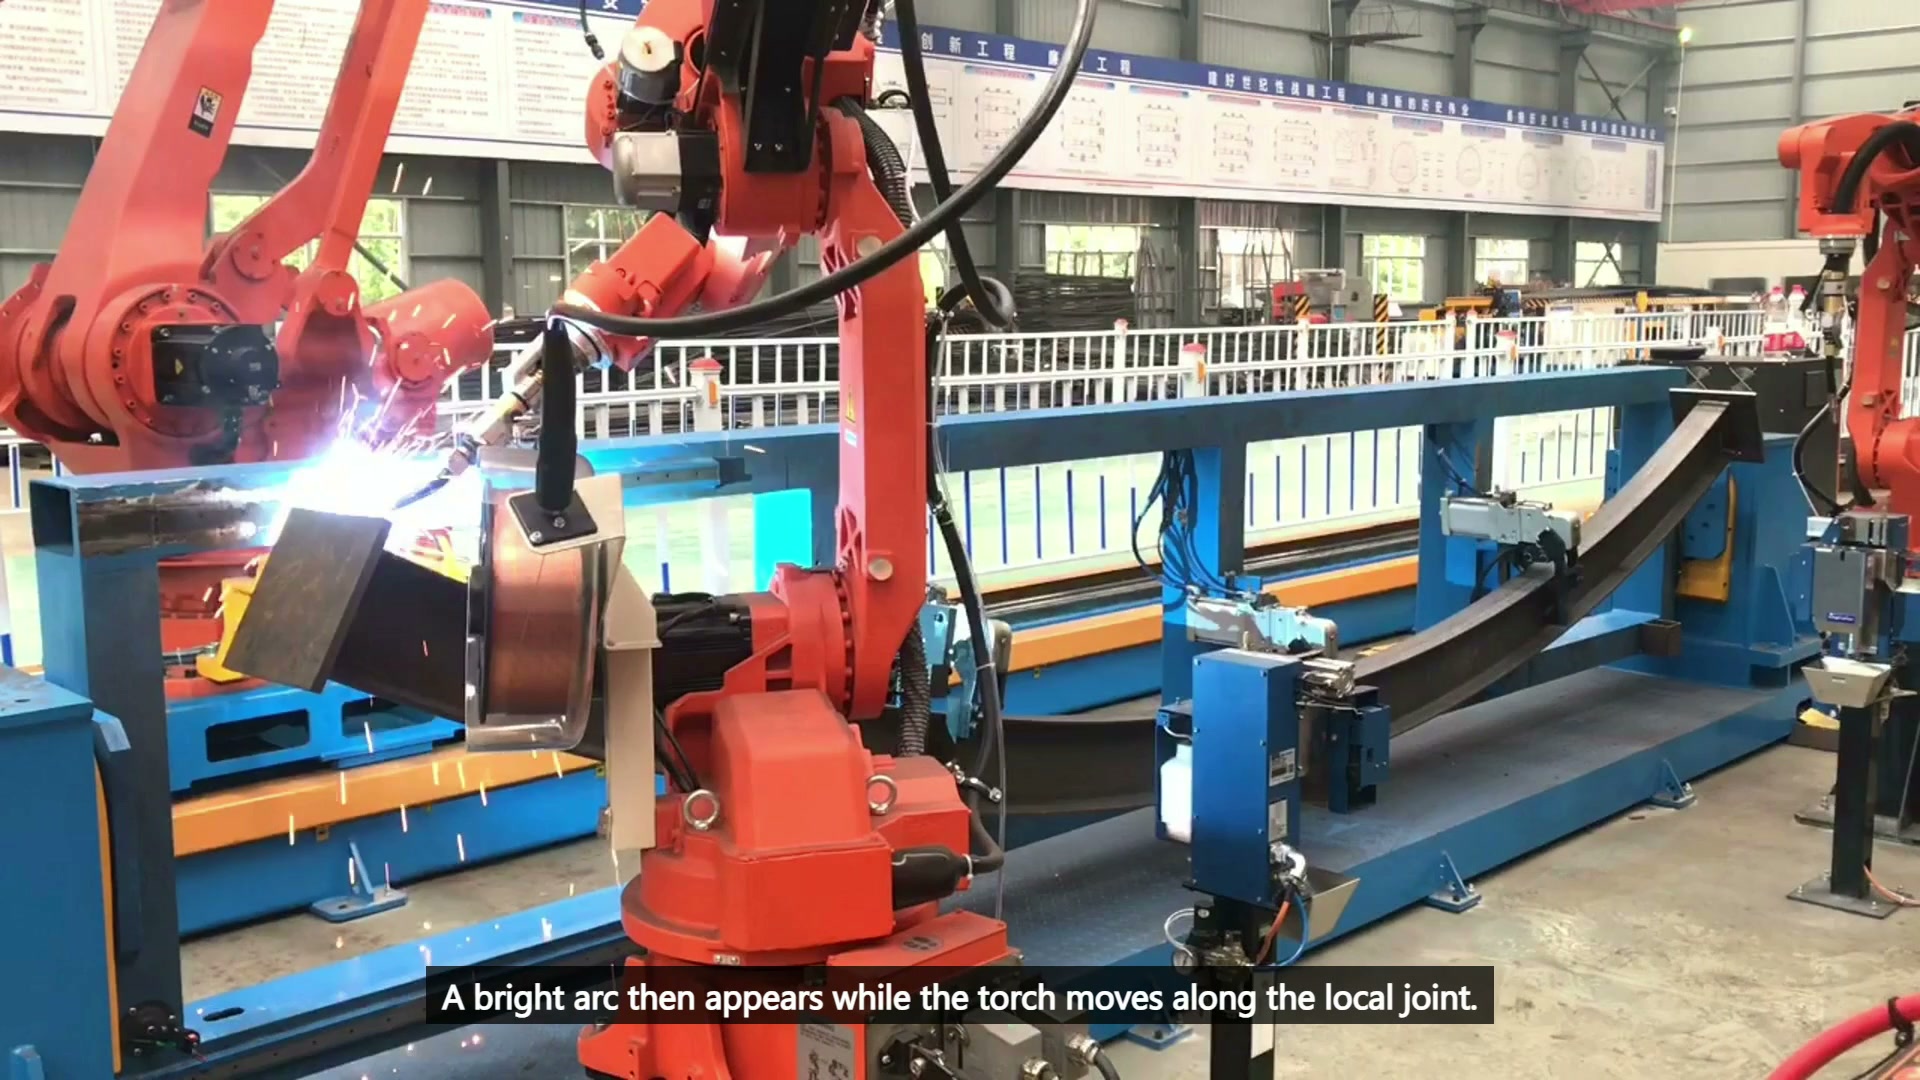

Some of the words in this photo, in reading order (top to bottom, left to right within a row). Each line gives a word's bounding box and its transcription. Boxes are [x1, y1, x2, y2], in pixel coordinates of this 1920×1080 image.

[921, 32, 1016, 60] 创新工程
[1047, 49, 1131, 76] 廉工程
